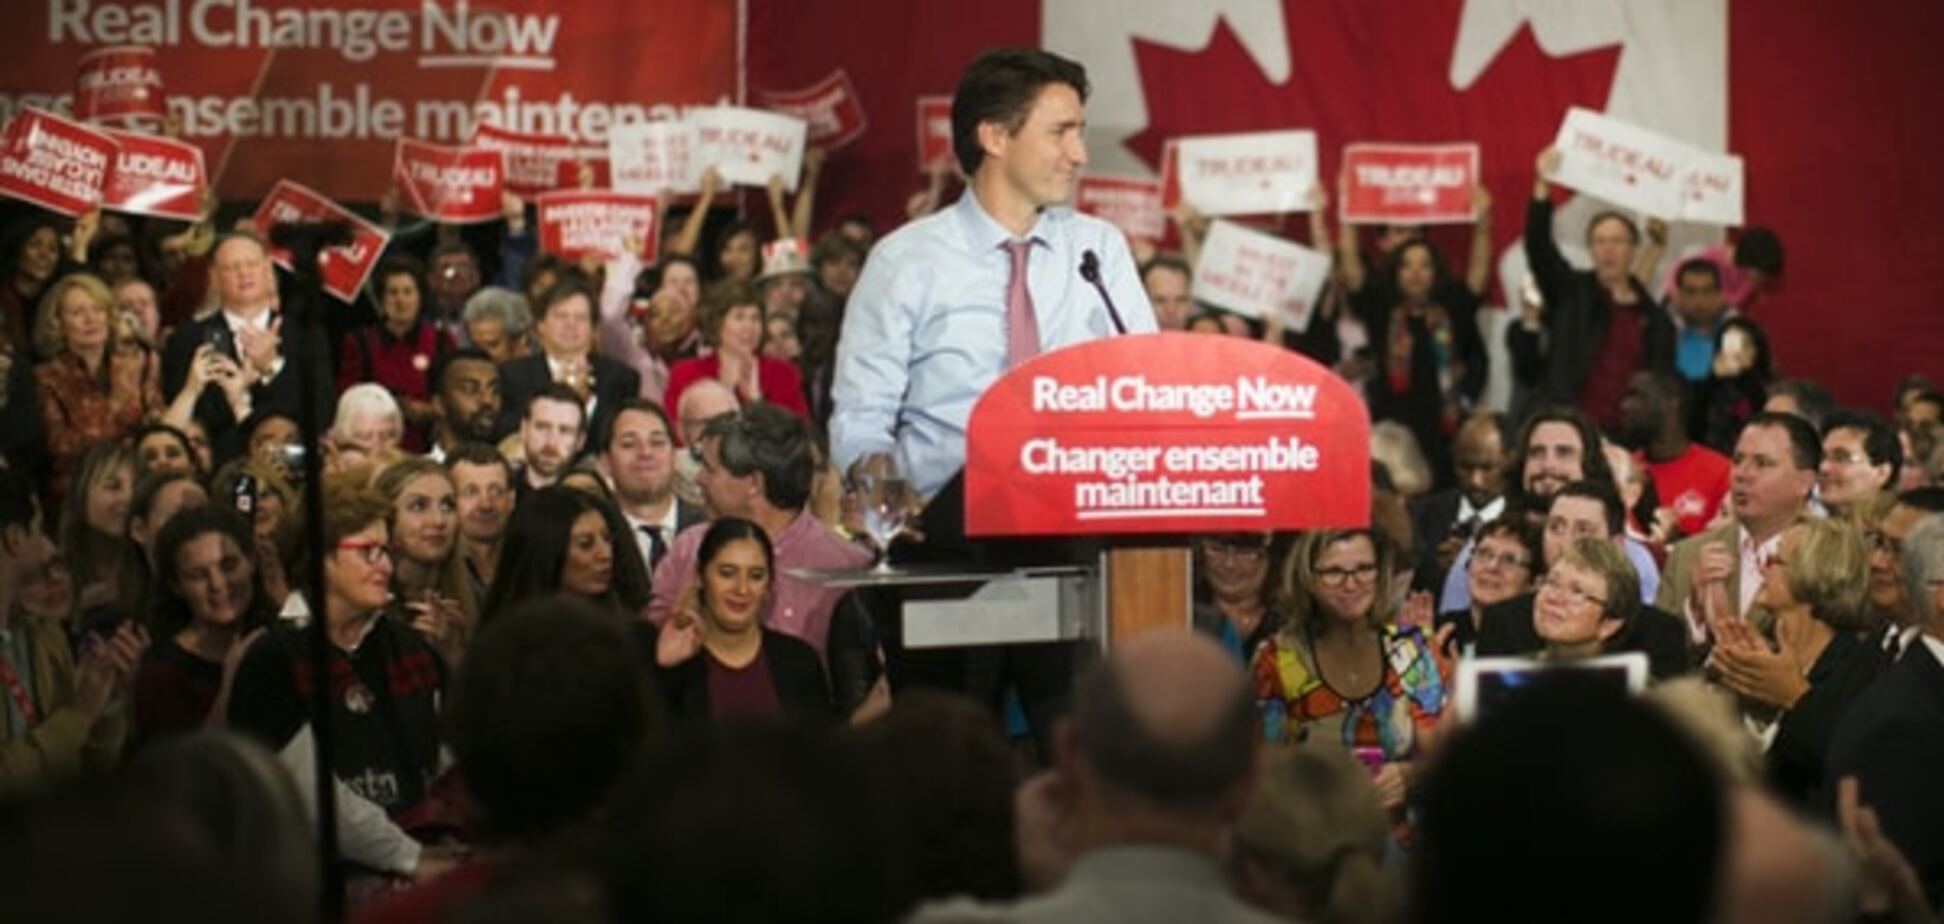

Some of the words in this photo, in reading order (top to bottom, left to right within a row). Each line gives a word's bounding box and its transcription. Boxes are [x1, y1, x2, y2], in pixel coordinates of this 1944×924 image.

[48, 0, 181, 45] Real
[190, 0, 410, 61] Change
[421, 0, 559, 52] Now
[117, 151, 196, 182] UDEAU
[1032, 374, 1106, 412] Real
[1111, 374, 1239, 417] Change
[1236, 375, 1316, 411] Now
[1020, 437, 1161, 476] Changer
[1165, 437, 1320, 472] ensemble
[1075, 475, 1264, 508] maintenant
